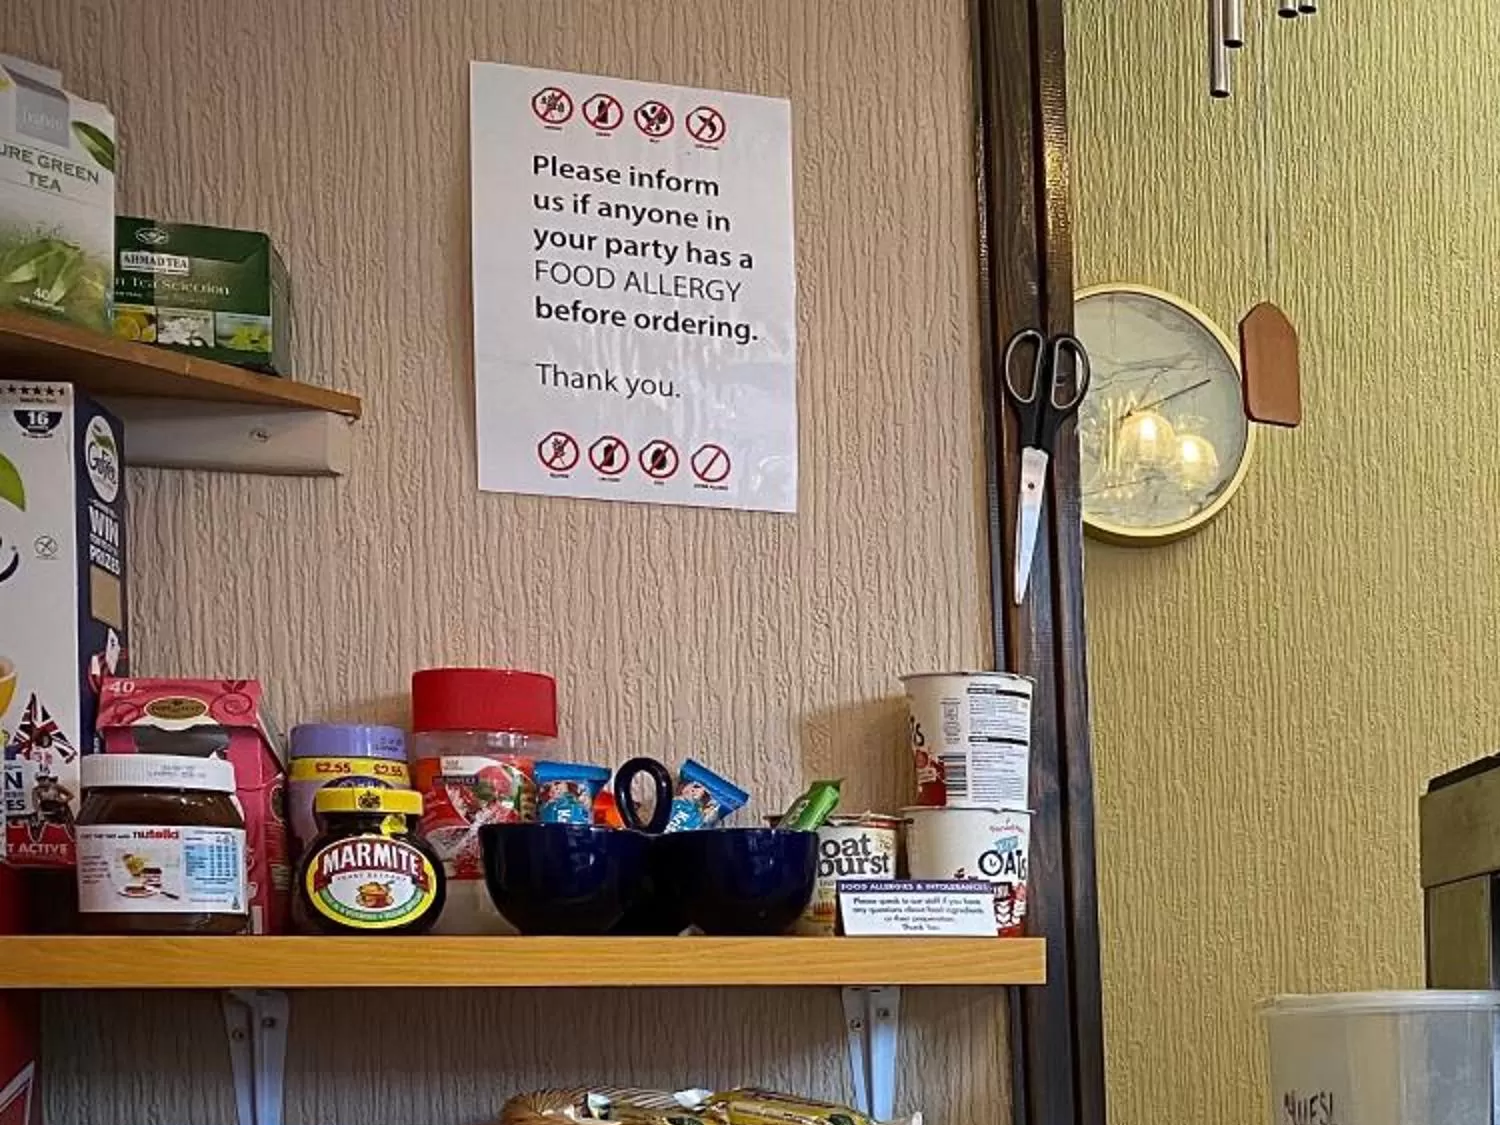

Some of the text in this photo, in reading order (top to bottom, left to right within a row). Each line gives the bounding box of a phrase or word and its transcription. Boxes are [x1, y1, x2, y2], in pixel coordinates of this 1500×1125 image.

[0, 146, 99, 184] URE GREEN
[533, 155, 719, 196] Please inform
[28, 171, 62, 193] TEA
[534, 193, 730, 232] us if anyone in
[123, 254, 165, 267] AHMAD
[534, 228, 753, 270] your party has a
[161, 280, 230, 296] Selection
[535, 260, 742, 303] FOOD ALLERGY
[536, 296, 759, 344] before ordering.
[536, 363, 681, 399] Thank you.
[109, 681, 135, 694] 40
[132, 829, 179, 840] nutella
[821, 833, 871, 858] oat
[323, 842, 421, 876] MARMITE
[978, 849, 1027, 880] OATS
[840, 883, 867, 891] FOOD
[870, 883, 914, 891] ALLERGIES
